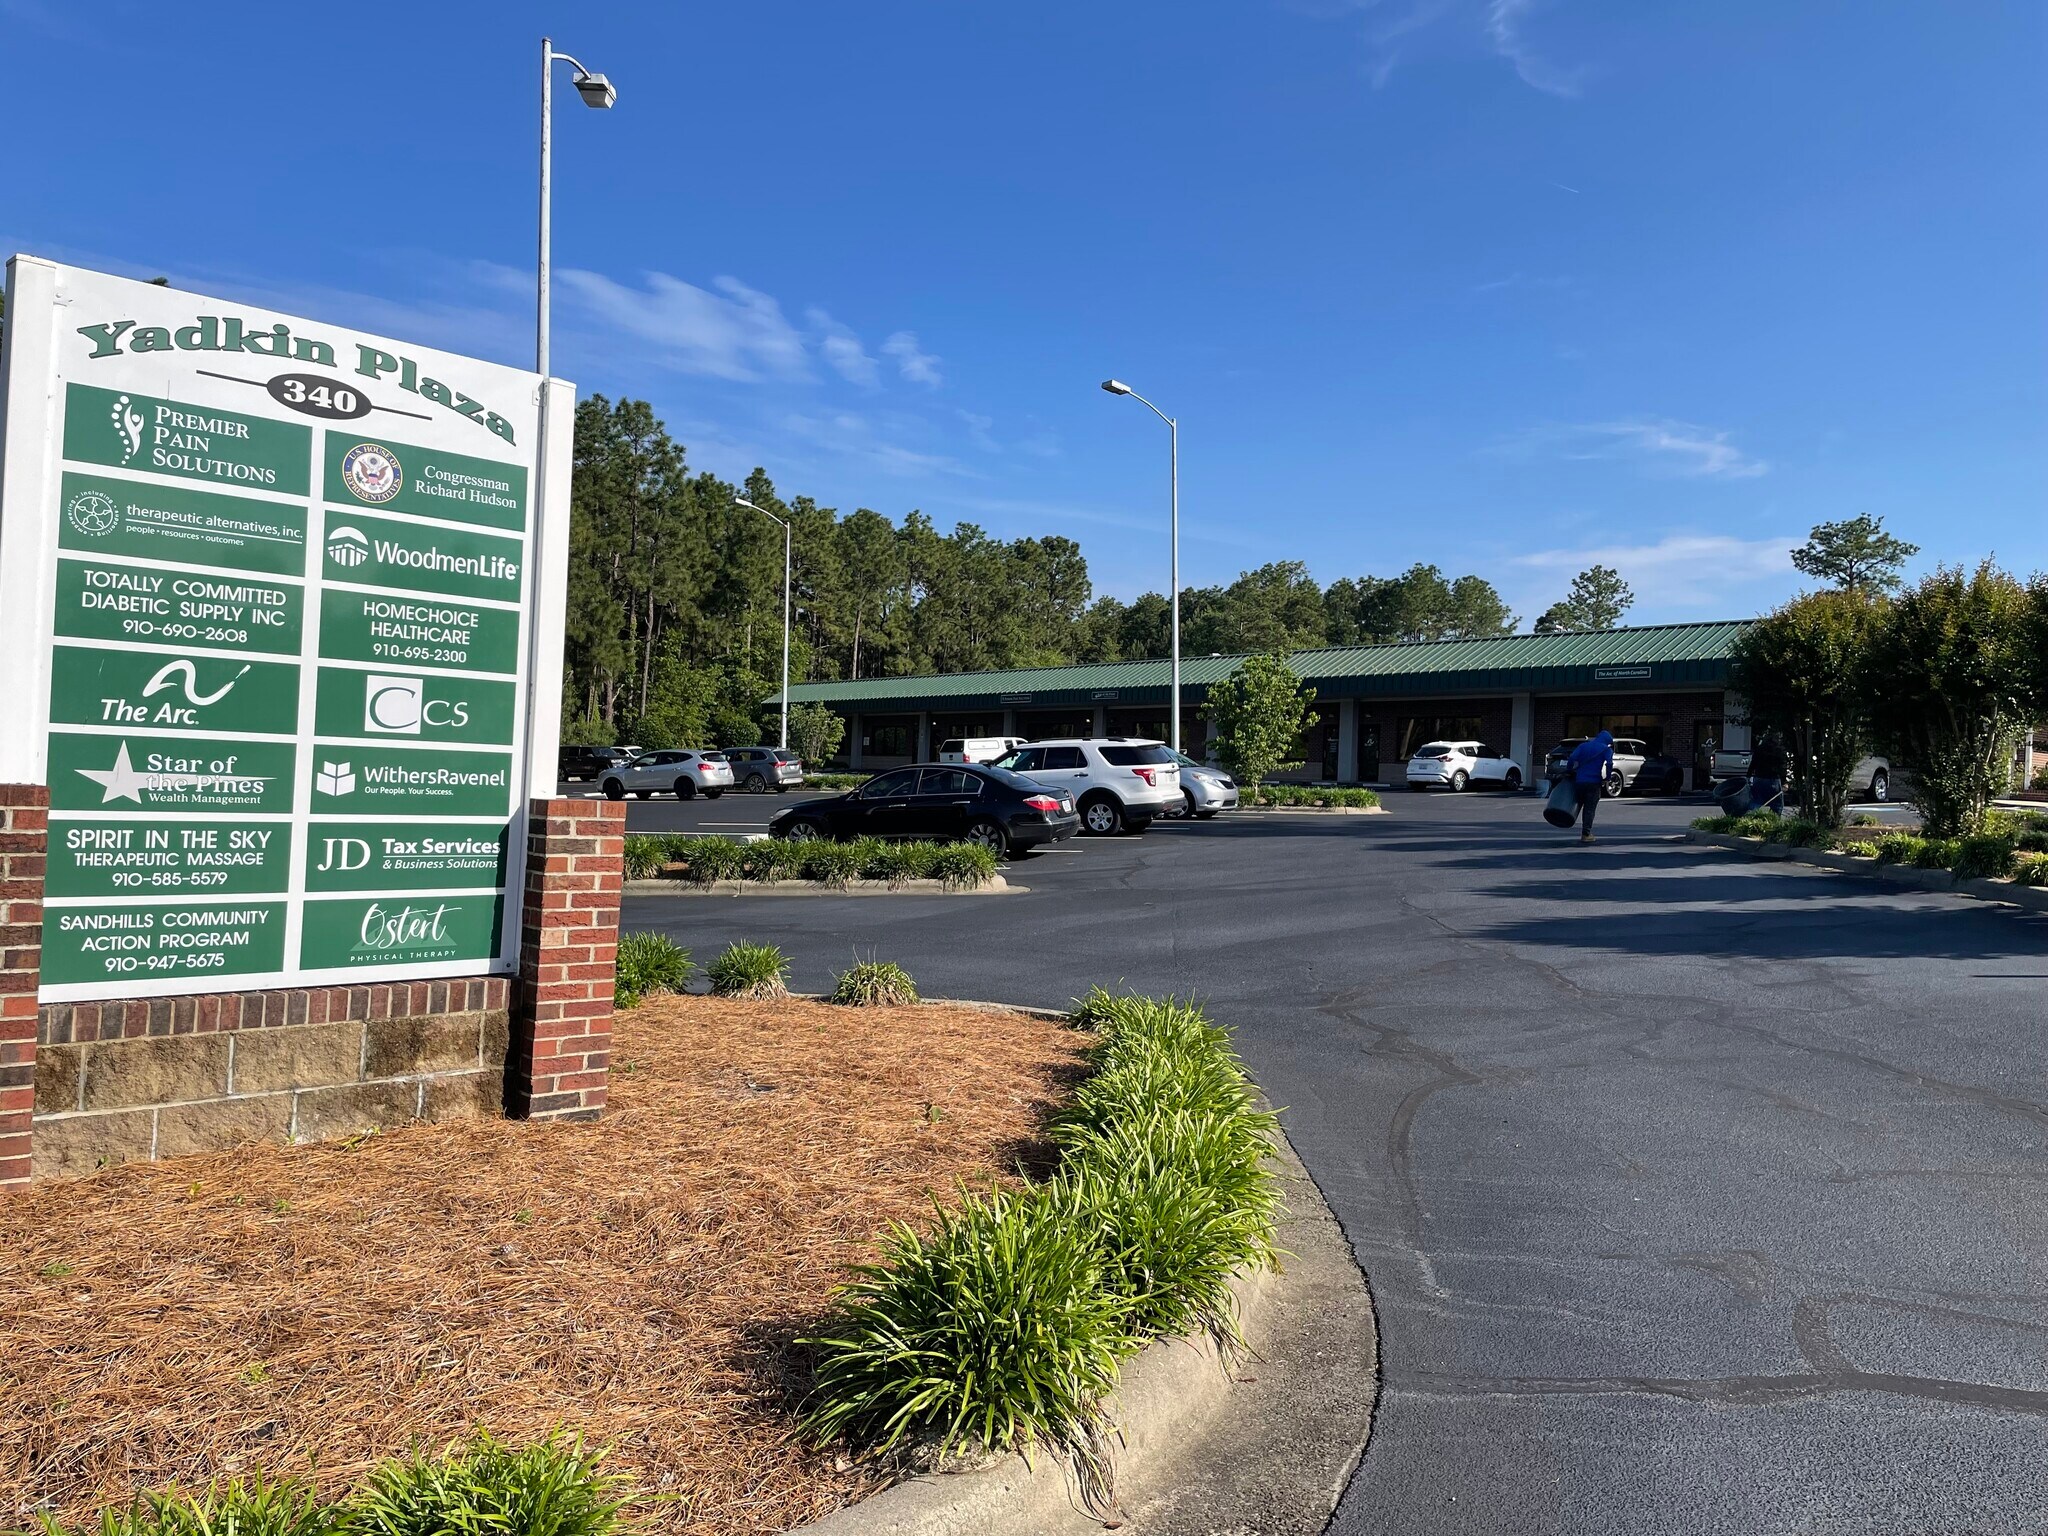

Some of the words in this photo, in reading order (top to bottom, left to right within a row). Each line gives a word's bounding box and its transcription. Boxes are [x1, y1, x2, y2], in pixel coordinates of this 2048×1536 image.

[77, 316, 337, 367] Yadkin
[355, 343, 516, 446] Plaza
[283, 379, 357, 413] 340
[155, 405, 250, 439] PREMIER
[154, 426, 210, 452] PAIN
[152, 448, 276, 485] SOLUTIONS
[364, 446, 391, 458] HOUSE
[390, 459, 400, 468] OF
[424, 465, 509, 491] Congressman
[80, 490, 113, 504] including
[415, 480, 466, 500] Richard
[470, 490, 517, 508] Hudson
[126, 504, 202, 525] therapeutic
[206, 515, 281, 537] alternatives,
[282, 528, 303, 538] inc.
[126, 525, 155, 535] people
[161, 531, 199, 540] resources
[205, 535, 244, 546] outcomes
[83, 570, 163, 593] TOTALLY
[172, 580, 286, 606] COMMITTED
[81, 591, 170, 615] DIABETIC
[179, 601, 243, 622] SUPPLY
[252, 609, 285, 626] INC
[364, 601, 479, 627] HOMECHOICE
[123, 619, 248, 643] 910-690-2608
[371, 621, 470, 645] HEALTHCARE
[373, 644, 467, 663] 910-695-2300
[100, 699, 148, 722] The
[147, 753, 202, 773] Star
[210, 756, 237, 774] of
[146, 774, 187, 793] the
[196, 775, 264, 794] Pines
[364, 766, 505, 786] WithersRavenel
[149, 793, 189, 803] Wealth
[191, 794, 261, 806] Management
[364, 786, 378, 794] Our
[380, 787, 406, 795] People.
[408, 787, 424, 795] Your
[66, 829, 134, 849] SPIRIT
[145, 830, 169, 849] IN
[181, 830, 218, 849] THE
[229, 830, 272, 849] SKY
[382, 838, 417, 854] Tax
[422, 838, 500, 854] Services
[75, 853, 180, 866] THERAPEUTIC
[187, 852, 264, 866] MASSAGE
[317, 838, 371, 871] JD
[383, 860, 392, 869] &
[394, 859, 444, 869] Business
[446, 858, 498, 868] Solutions
[112, 872, 227, 886] 910-585-5579
[60, 913, 153, 930] SANDHILLS
[162, 910, 269, 927] COMMUNITY
[361, 903, 462, 949] Ostert
[81, 934, 150, 951] ACTION
[160, 931, 249, 949] PROGRAM
[105, 953, 225, 972] 910-947-5675
[350, 954, 403, 962] PHYSICAL
[410, 950, 456, 958] THERAPY
